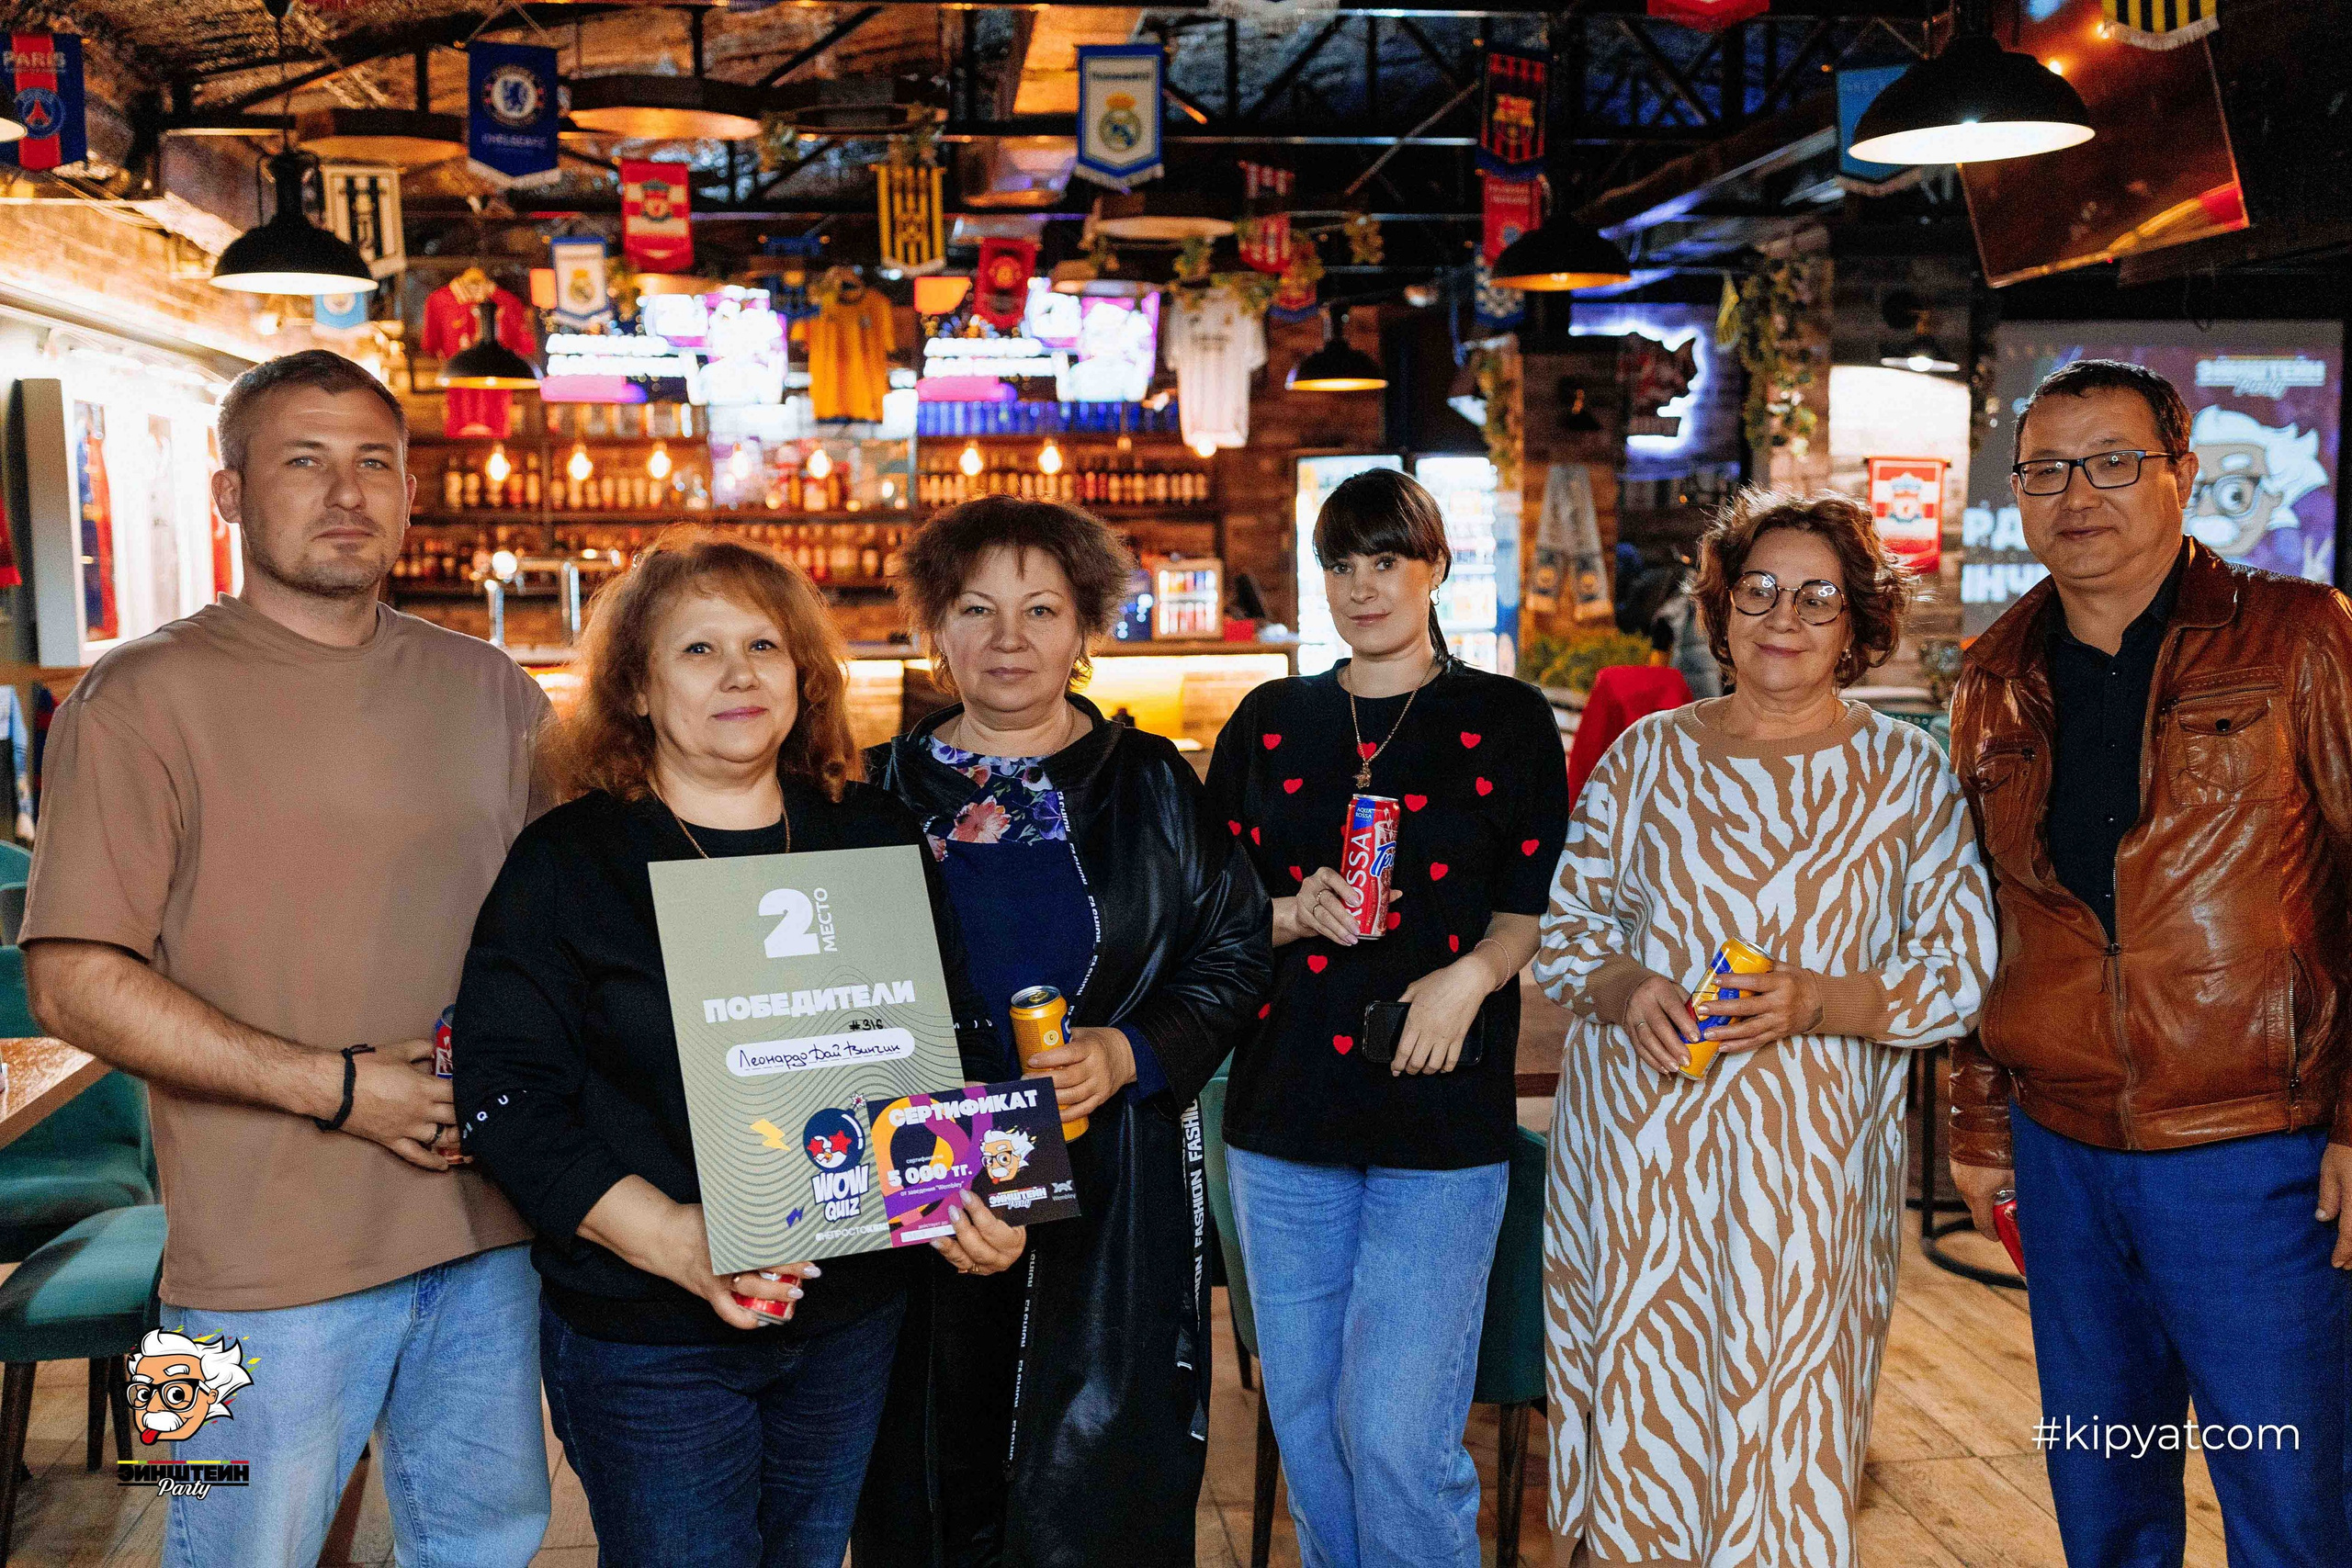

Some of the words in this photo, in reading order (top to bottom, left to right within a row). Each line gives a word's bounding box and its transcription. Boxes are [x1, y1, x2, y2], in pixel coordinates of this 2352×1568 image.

[758, 888, 820, 958] 2
[813, 887, 838, 953] МЕСТО
[703, 979, 916, 1023] ПОБЕДИТЕЛИ
[849, 1019, 884, 1031] #316
[740, 1049, 808, 1069] Леонардо
[808, 1043, 842, 1064] Дай
[888, 1089, 1038, 1127] СЕРТИФИКАТ
[812, 1165, 869, 1203] WOW
[887, 1169, 902, 1187] 5
[905, 1163, 948, 1184] 000
[825, 1197, 860, 1221] QUIZ
[1191, 1169, 1204, 1248] FASHION
